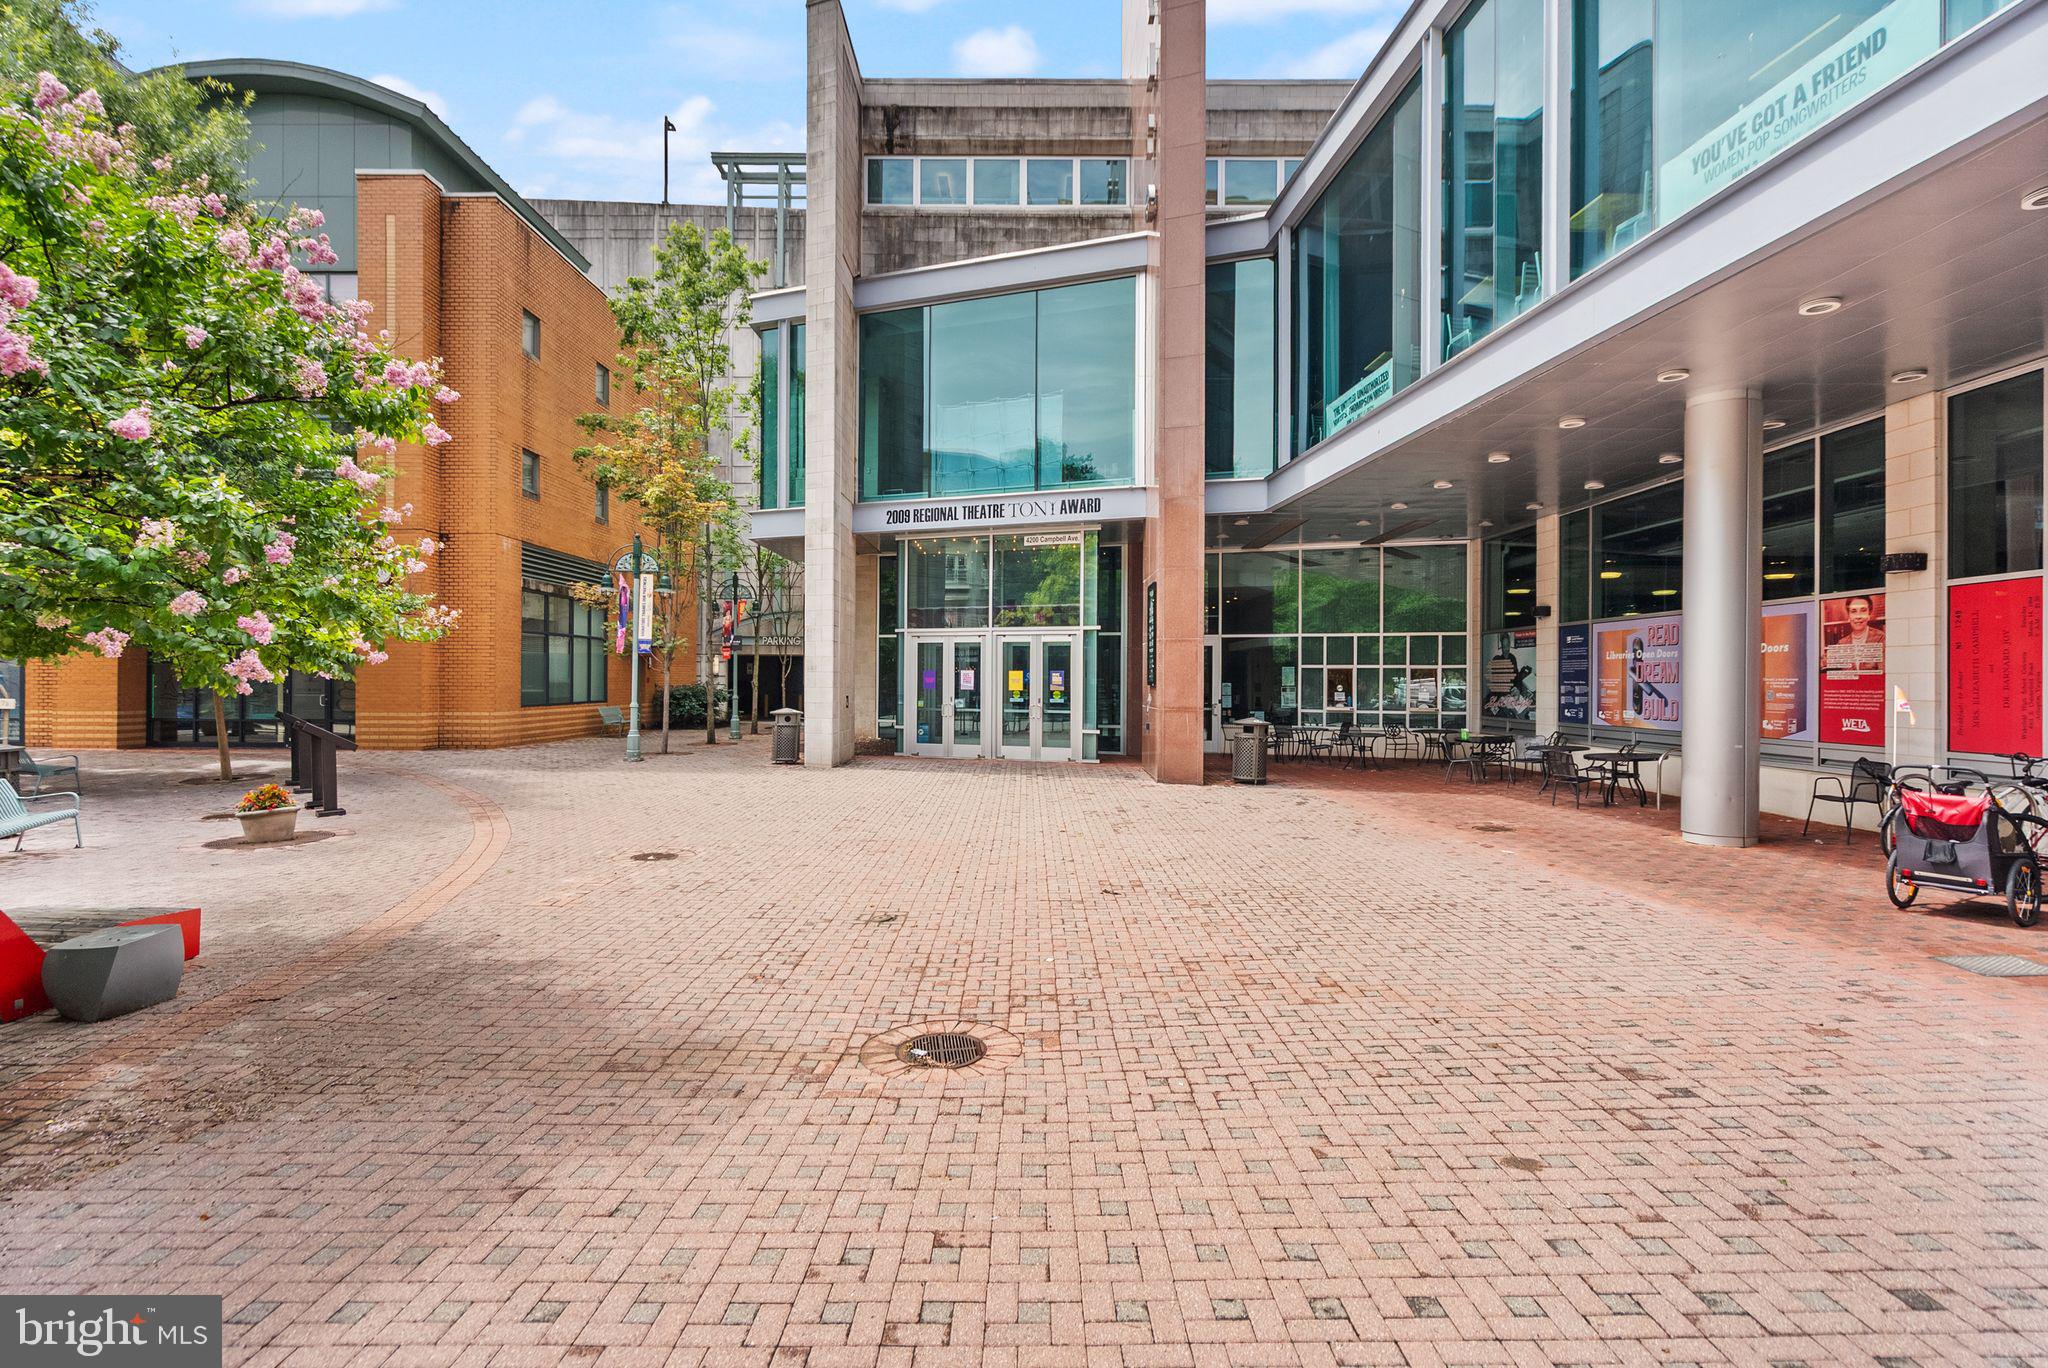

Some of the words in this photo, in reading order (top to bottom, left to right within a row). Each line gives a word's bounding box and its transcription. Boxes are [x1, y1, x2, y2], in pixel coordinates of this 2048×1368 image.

[1691, 117, 1748, 175] YOU'VE
[1751, 94, 1788, 135] GOT
[1792, 84, 1808, 109] A
[1812, 27, 1888, 96] FRIEND
[1704, 149, 1745, 184] WOMEN
[1747, 131, 1770, 158] POP
[1773, 66, 1868, 142] SONGWRITERS
[1348, 395, 1374, 415] THOMPSON
[886, 509, 910, 525] 2009
[913, 505, 960, 523] REGIONAL
[962, 503, 1006, 520] THEATRE
[1008, 500, 1056, 518] TONY
[1060, 497, 1101, 515] AWARD
[762, 636, 801, 646] PARKING
[1648, 624, 1680, 647] READ
[1972, 611, 1980, 654] CAMPBELL
[2002, 630, 2011, 646] JOY
[1606, 650, 1634, 660] Libraries
[1636, 650, 1656, 660] Open
[1656, 648, 1678, 658] Doors
[1760, 642, 1790, 654] Doors
[1636, 661, 1680, 684] DREAM
[2002, 648, 2010, 691] BARNARD
[1972, 658, 1980, 705] ELIZABETH
[1644, 698, 1678, 722] BUILD
[1842, 718, 1868, 729] WETA
